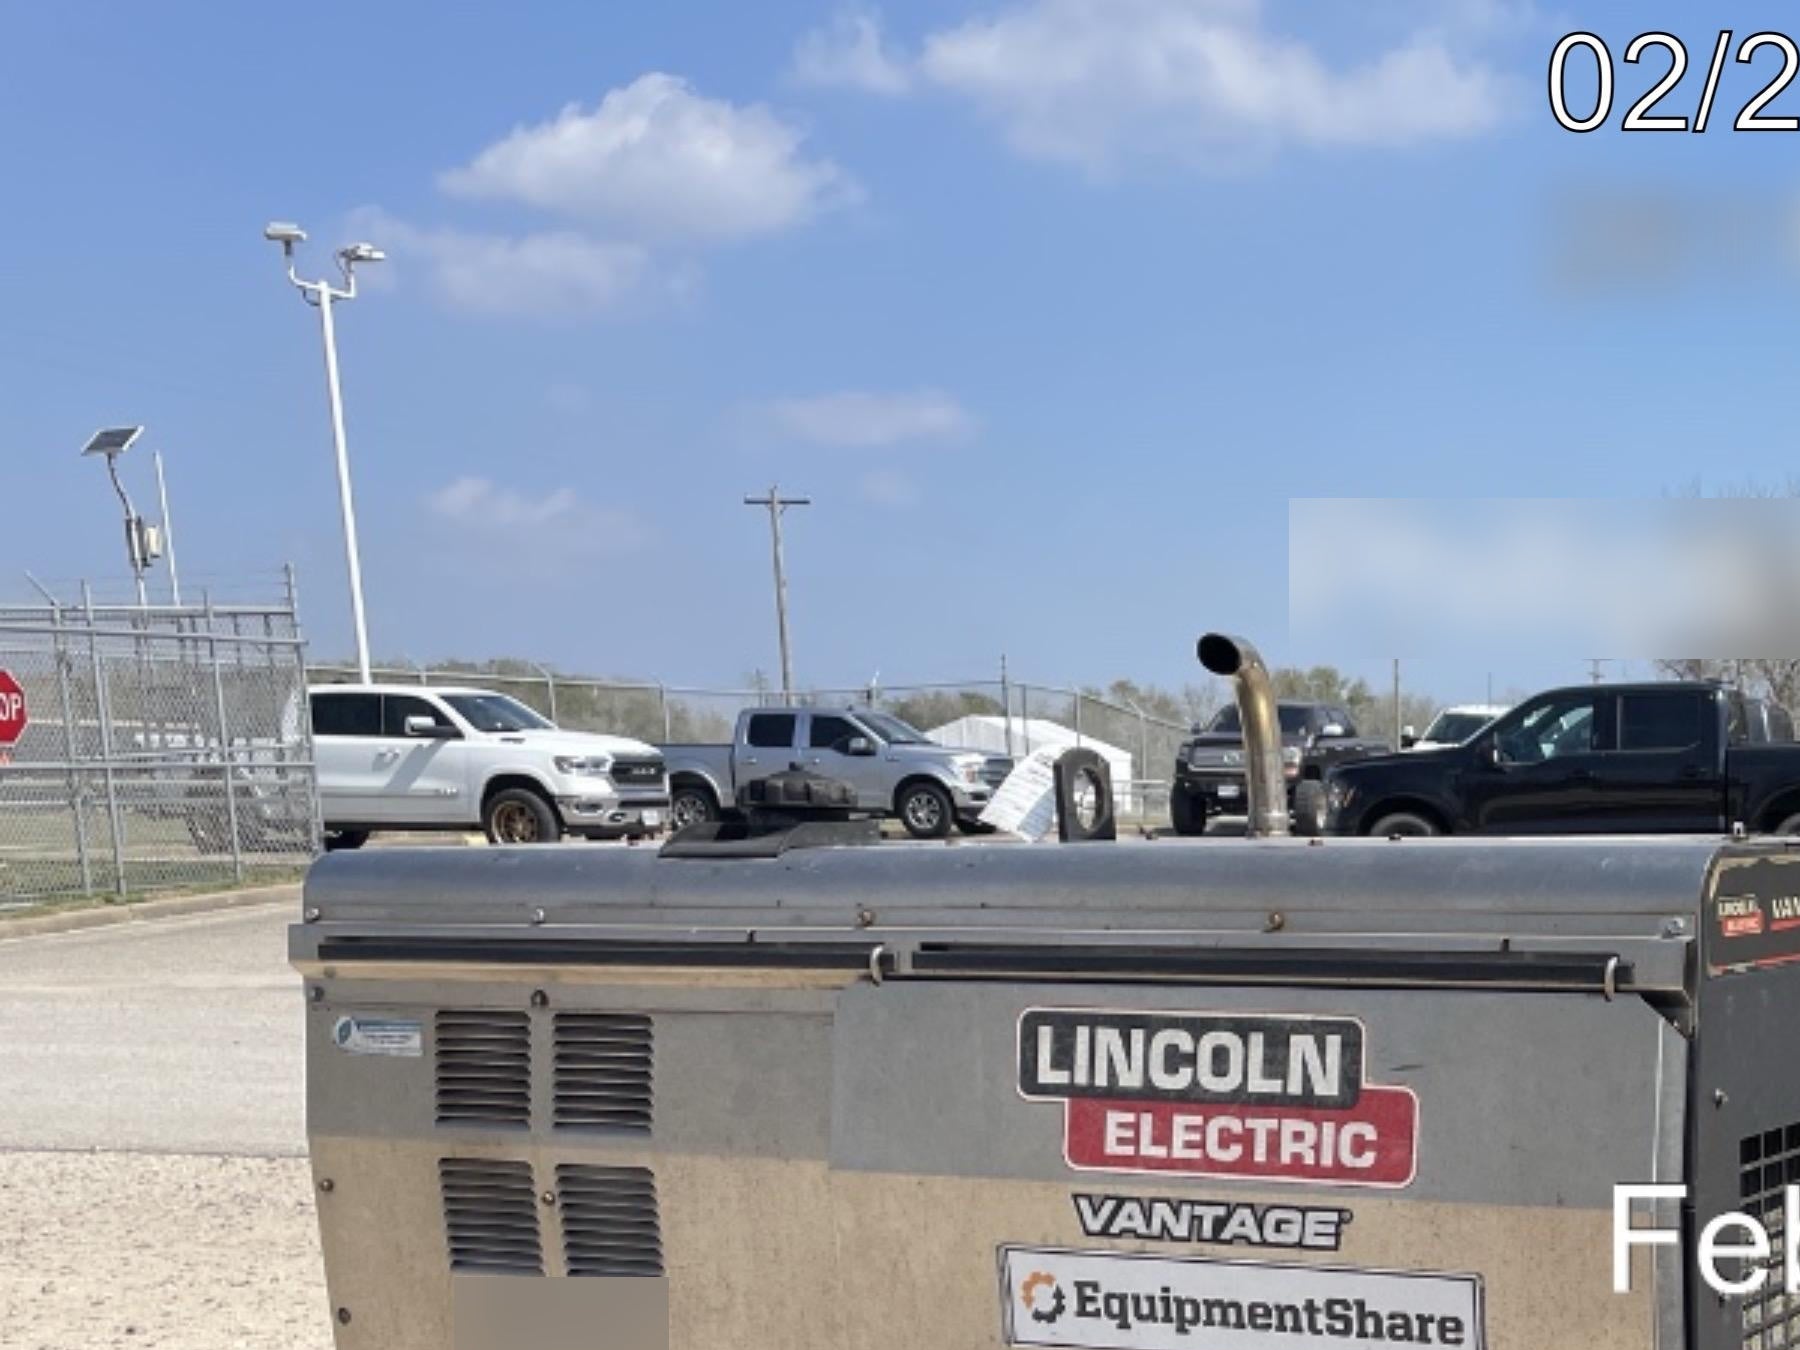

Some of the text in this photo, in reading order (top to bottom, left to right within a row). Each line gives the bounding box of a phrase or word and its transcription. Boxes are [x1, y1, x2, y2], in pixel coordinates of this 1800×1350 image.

[1036, 1025, 1343, 1096] LINCOLN
[1104, 1111, 1379, 1169] ELECTRIC
[1073, 1195, 1344, 1249] VANTAGE
[1073, 1281, 1465, 1345] EquipmentShare
